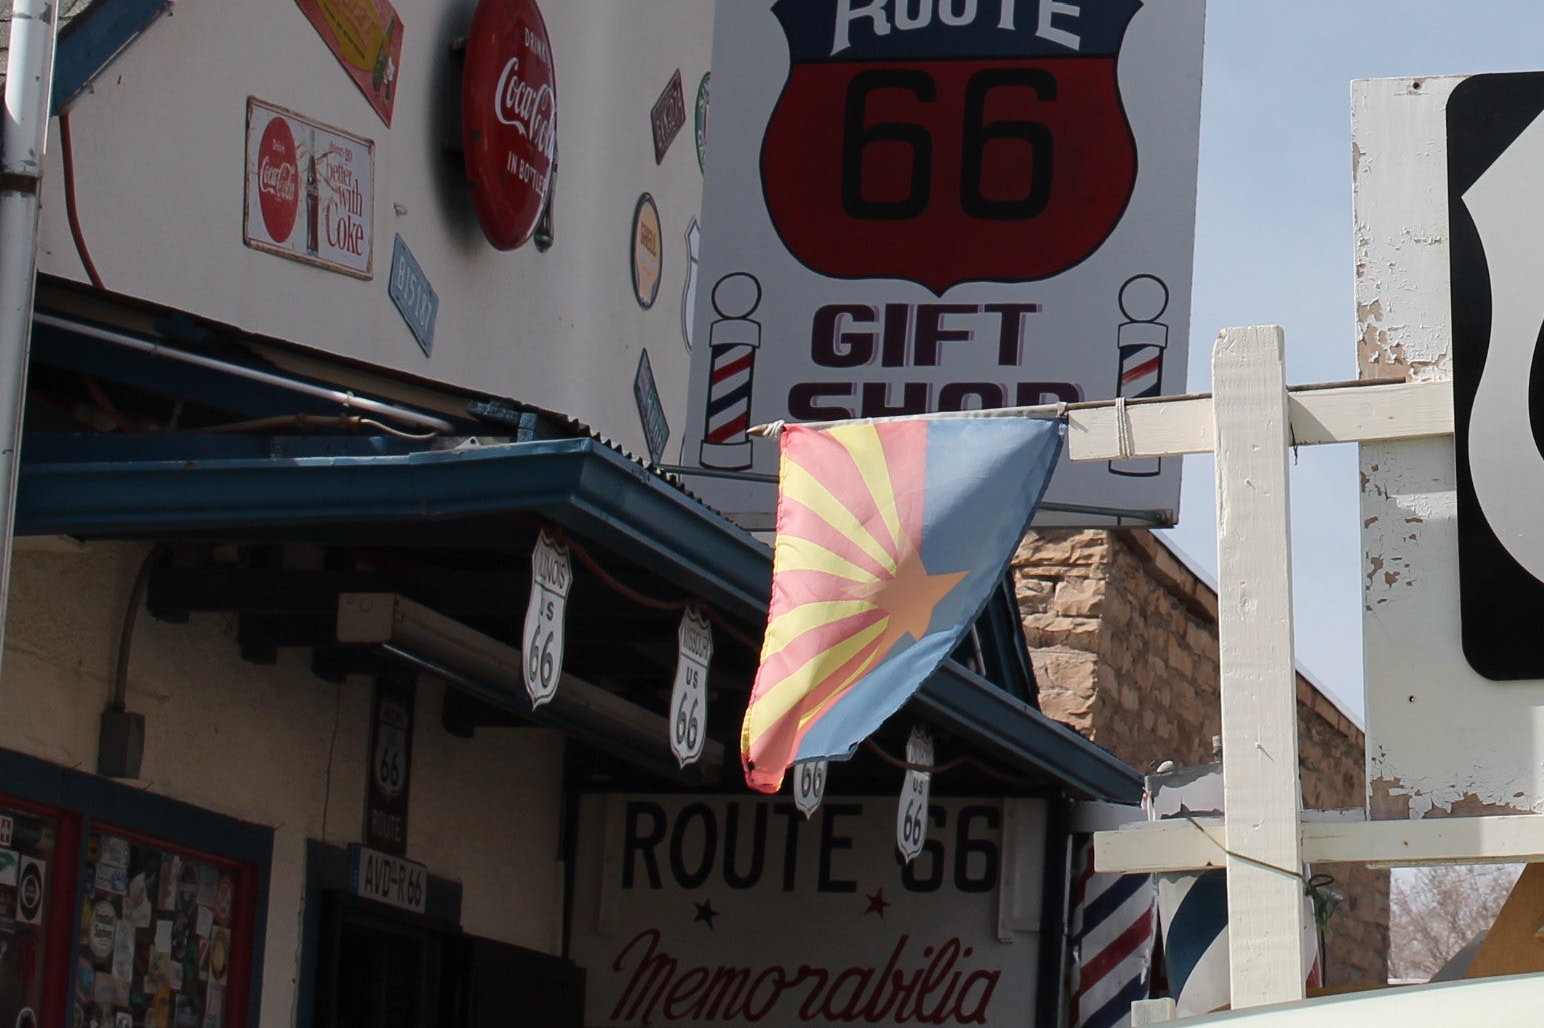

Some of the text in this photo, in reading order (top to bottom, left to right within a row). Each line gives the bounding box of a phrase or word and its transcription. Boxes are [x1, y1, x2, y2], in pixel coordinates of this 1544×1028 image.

[507, 150, 547, 196] IN BOTTLE
[841, 68, 1058, 222] 66
[325, 197, 365, 257] Coke
[338, 178, 363, 218] with
[810, 303, 1043, 369] GIFT
[529, 624, 554, 688] 66
[686, 666, 699, 690] US
[676, 692, 699, 750] 66
[380, 747, 400, 786] 66
[912, 778, 925, 795] US
[621, 801, 1000, 894] ROUTE 66
[903, 799, 922, 846] 66
[609, 928, 1002, 1026] Memorabilia
